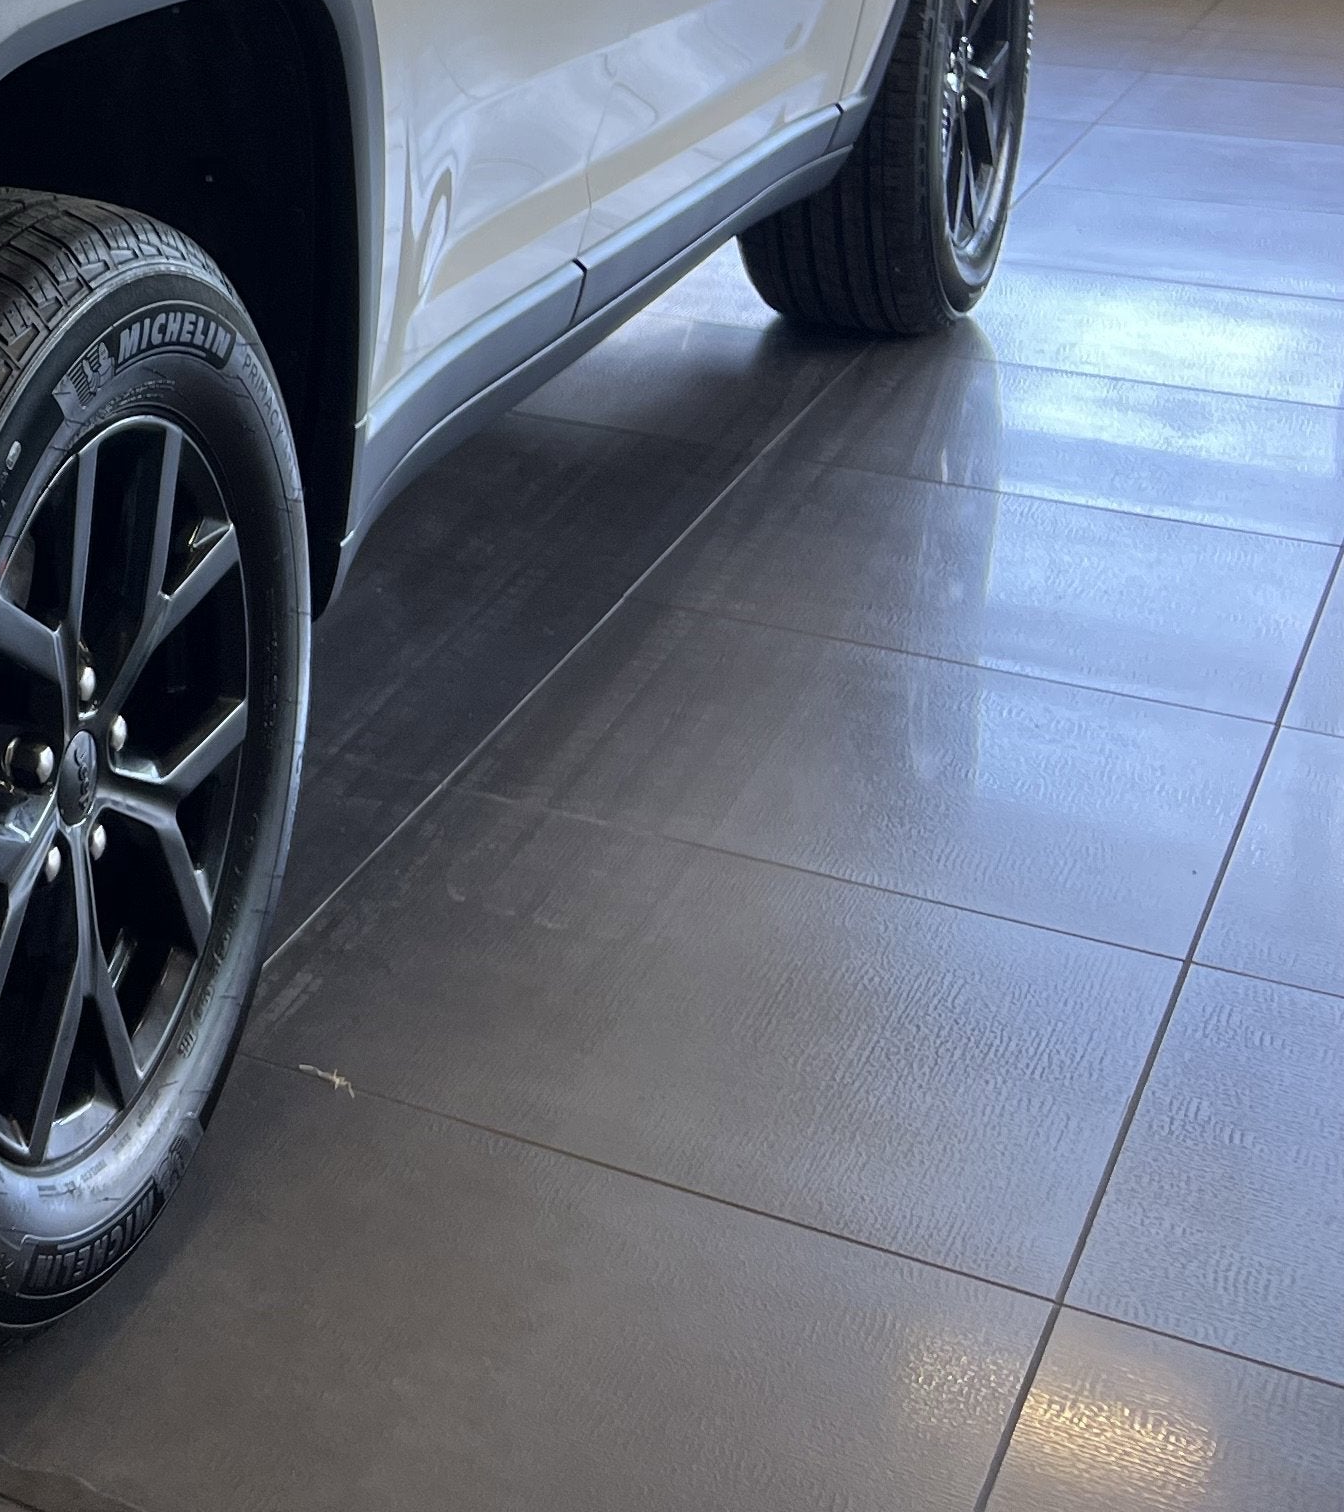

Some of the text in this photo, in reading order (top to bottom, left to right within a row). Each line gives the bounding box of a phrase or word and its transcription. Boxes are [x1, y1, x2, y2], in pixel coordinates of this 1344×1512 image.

[117, 311, 232, 366] MICHELIN
[241, 352, 285, 439] PRIMACY
[26, 1186, 156, 1290] MICHELIN
